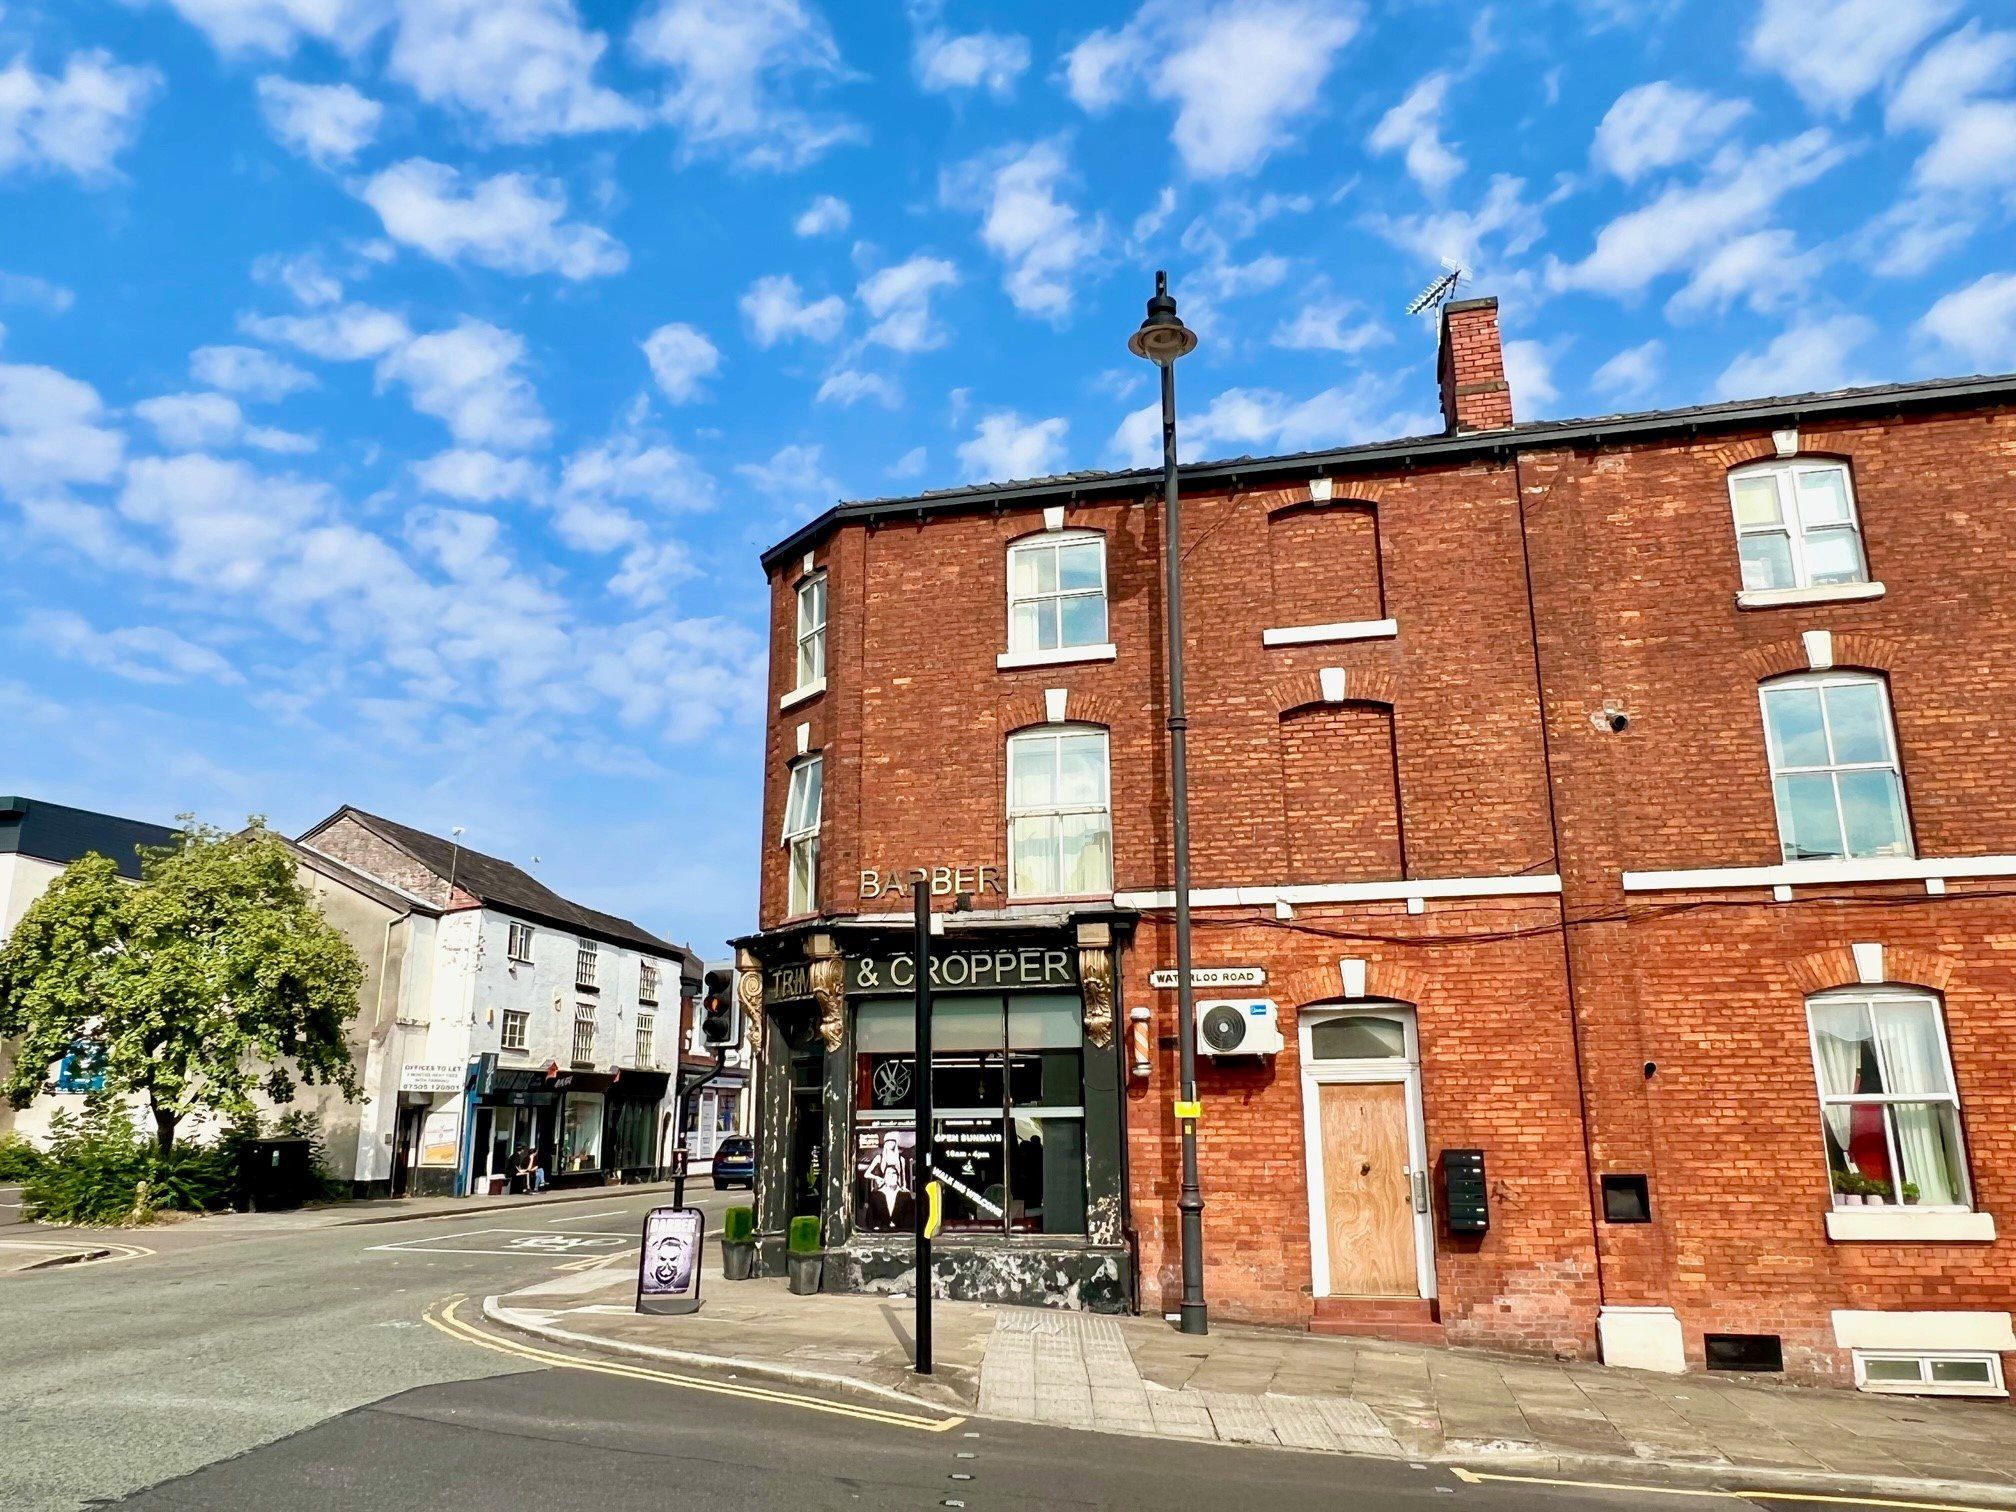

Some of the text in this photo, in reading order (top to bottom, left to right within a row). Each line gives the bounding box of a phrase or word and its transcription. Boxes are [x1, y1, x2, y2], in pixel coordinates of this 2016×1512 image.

[860, 865, 1003, 899] BARBER
[857, 957, 880, 987] &
[1157, 972, 1255, 983] WATRLOO ROAD
[404, 1064, 435, 1072] OFFICES
[934, 1134, 1002, 1142] OPEN SUNDAYS
[932, 1166, 954, 1185] WALK
[965, 1188, 1004, 1218] WELCOME
